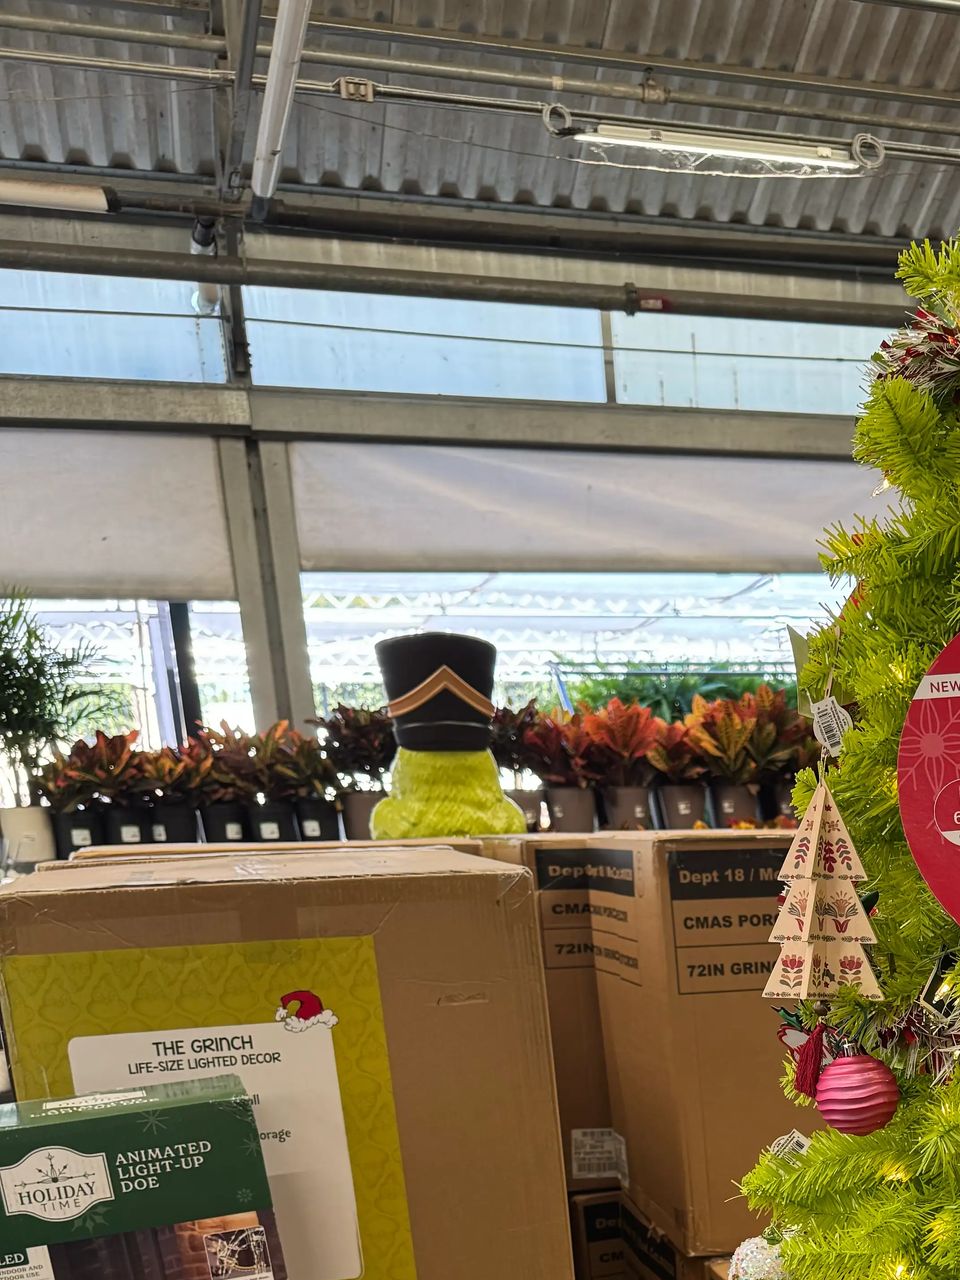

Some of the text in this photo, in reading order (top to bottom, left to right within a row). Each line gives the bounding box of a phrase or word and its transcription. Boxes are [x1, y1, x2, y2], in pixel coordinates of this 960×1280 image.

[678, 869, 719, 886] Dept
[724, 868, 745, 882] 18
[683, 914, 732, 930] CMAS
[687, 960, 776, 977] 72IN GRIN
[152, 1035, 254, 1057] THE GRINCH
[128, 1052, 282, 1075] LIFE-SIZE LIGHTED DECOR
[260, 1128, 292, 1142] orage
[116, 1141, 212, 1166] ANIMATED
[117, 1156, 204, 1179] LIGHT-UP
[120, 1176, 160, 1193] DOE
[18, 1182, 96, 1205] HOLIDAY
[40, 1199, 81, 1212] TIME
[0, 1267, 27, 1275] NDOOR
